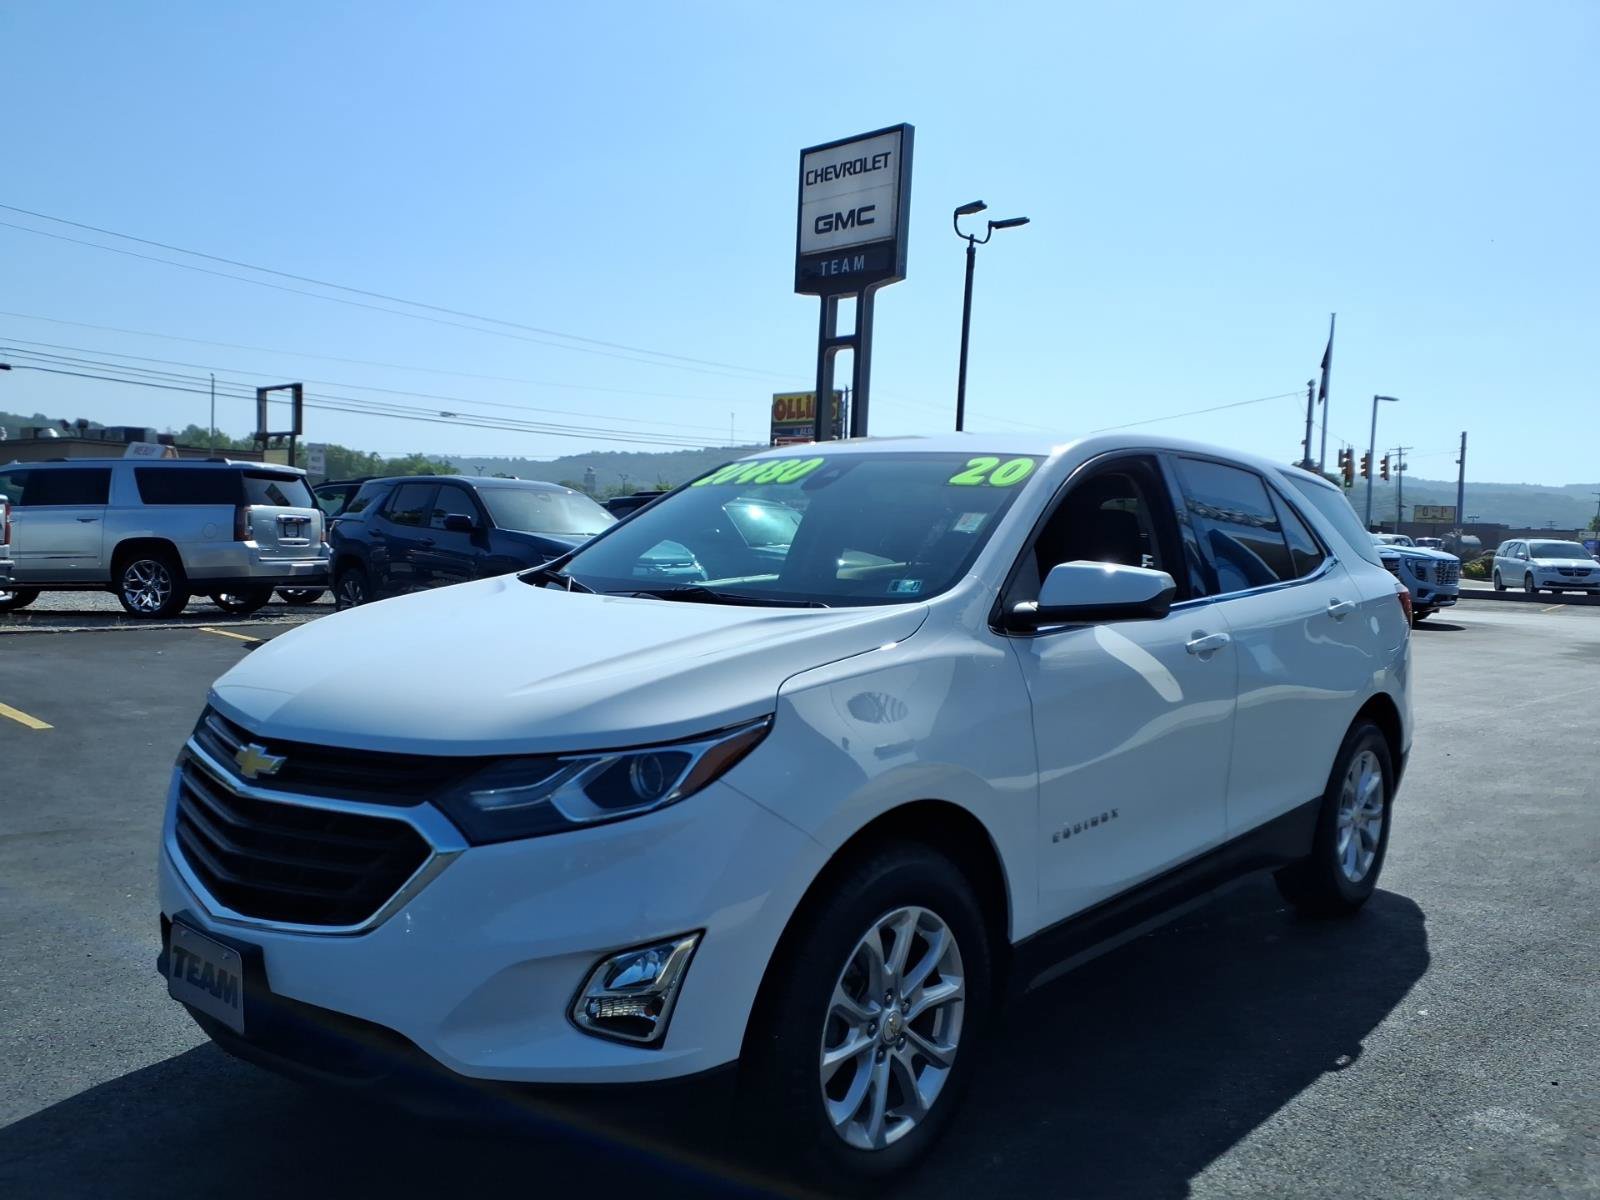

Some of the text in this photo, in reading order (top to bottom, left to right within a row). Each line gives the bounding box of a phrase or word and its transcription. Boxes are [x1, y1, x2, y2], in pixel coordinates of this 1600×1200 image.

[805, 152, 892, 186] CHEVROLET
[815, 205, 876, 235] GMC
[820, 254, 866, 277] TEAM
[948, 456, 1035, 487] 20
[1052, 807, 1119, 844] EQUINOX
[172, 944, 239, 1010] TEAM
